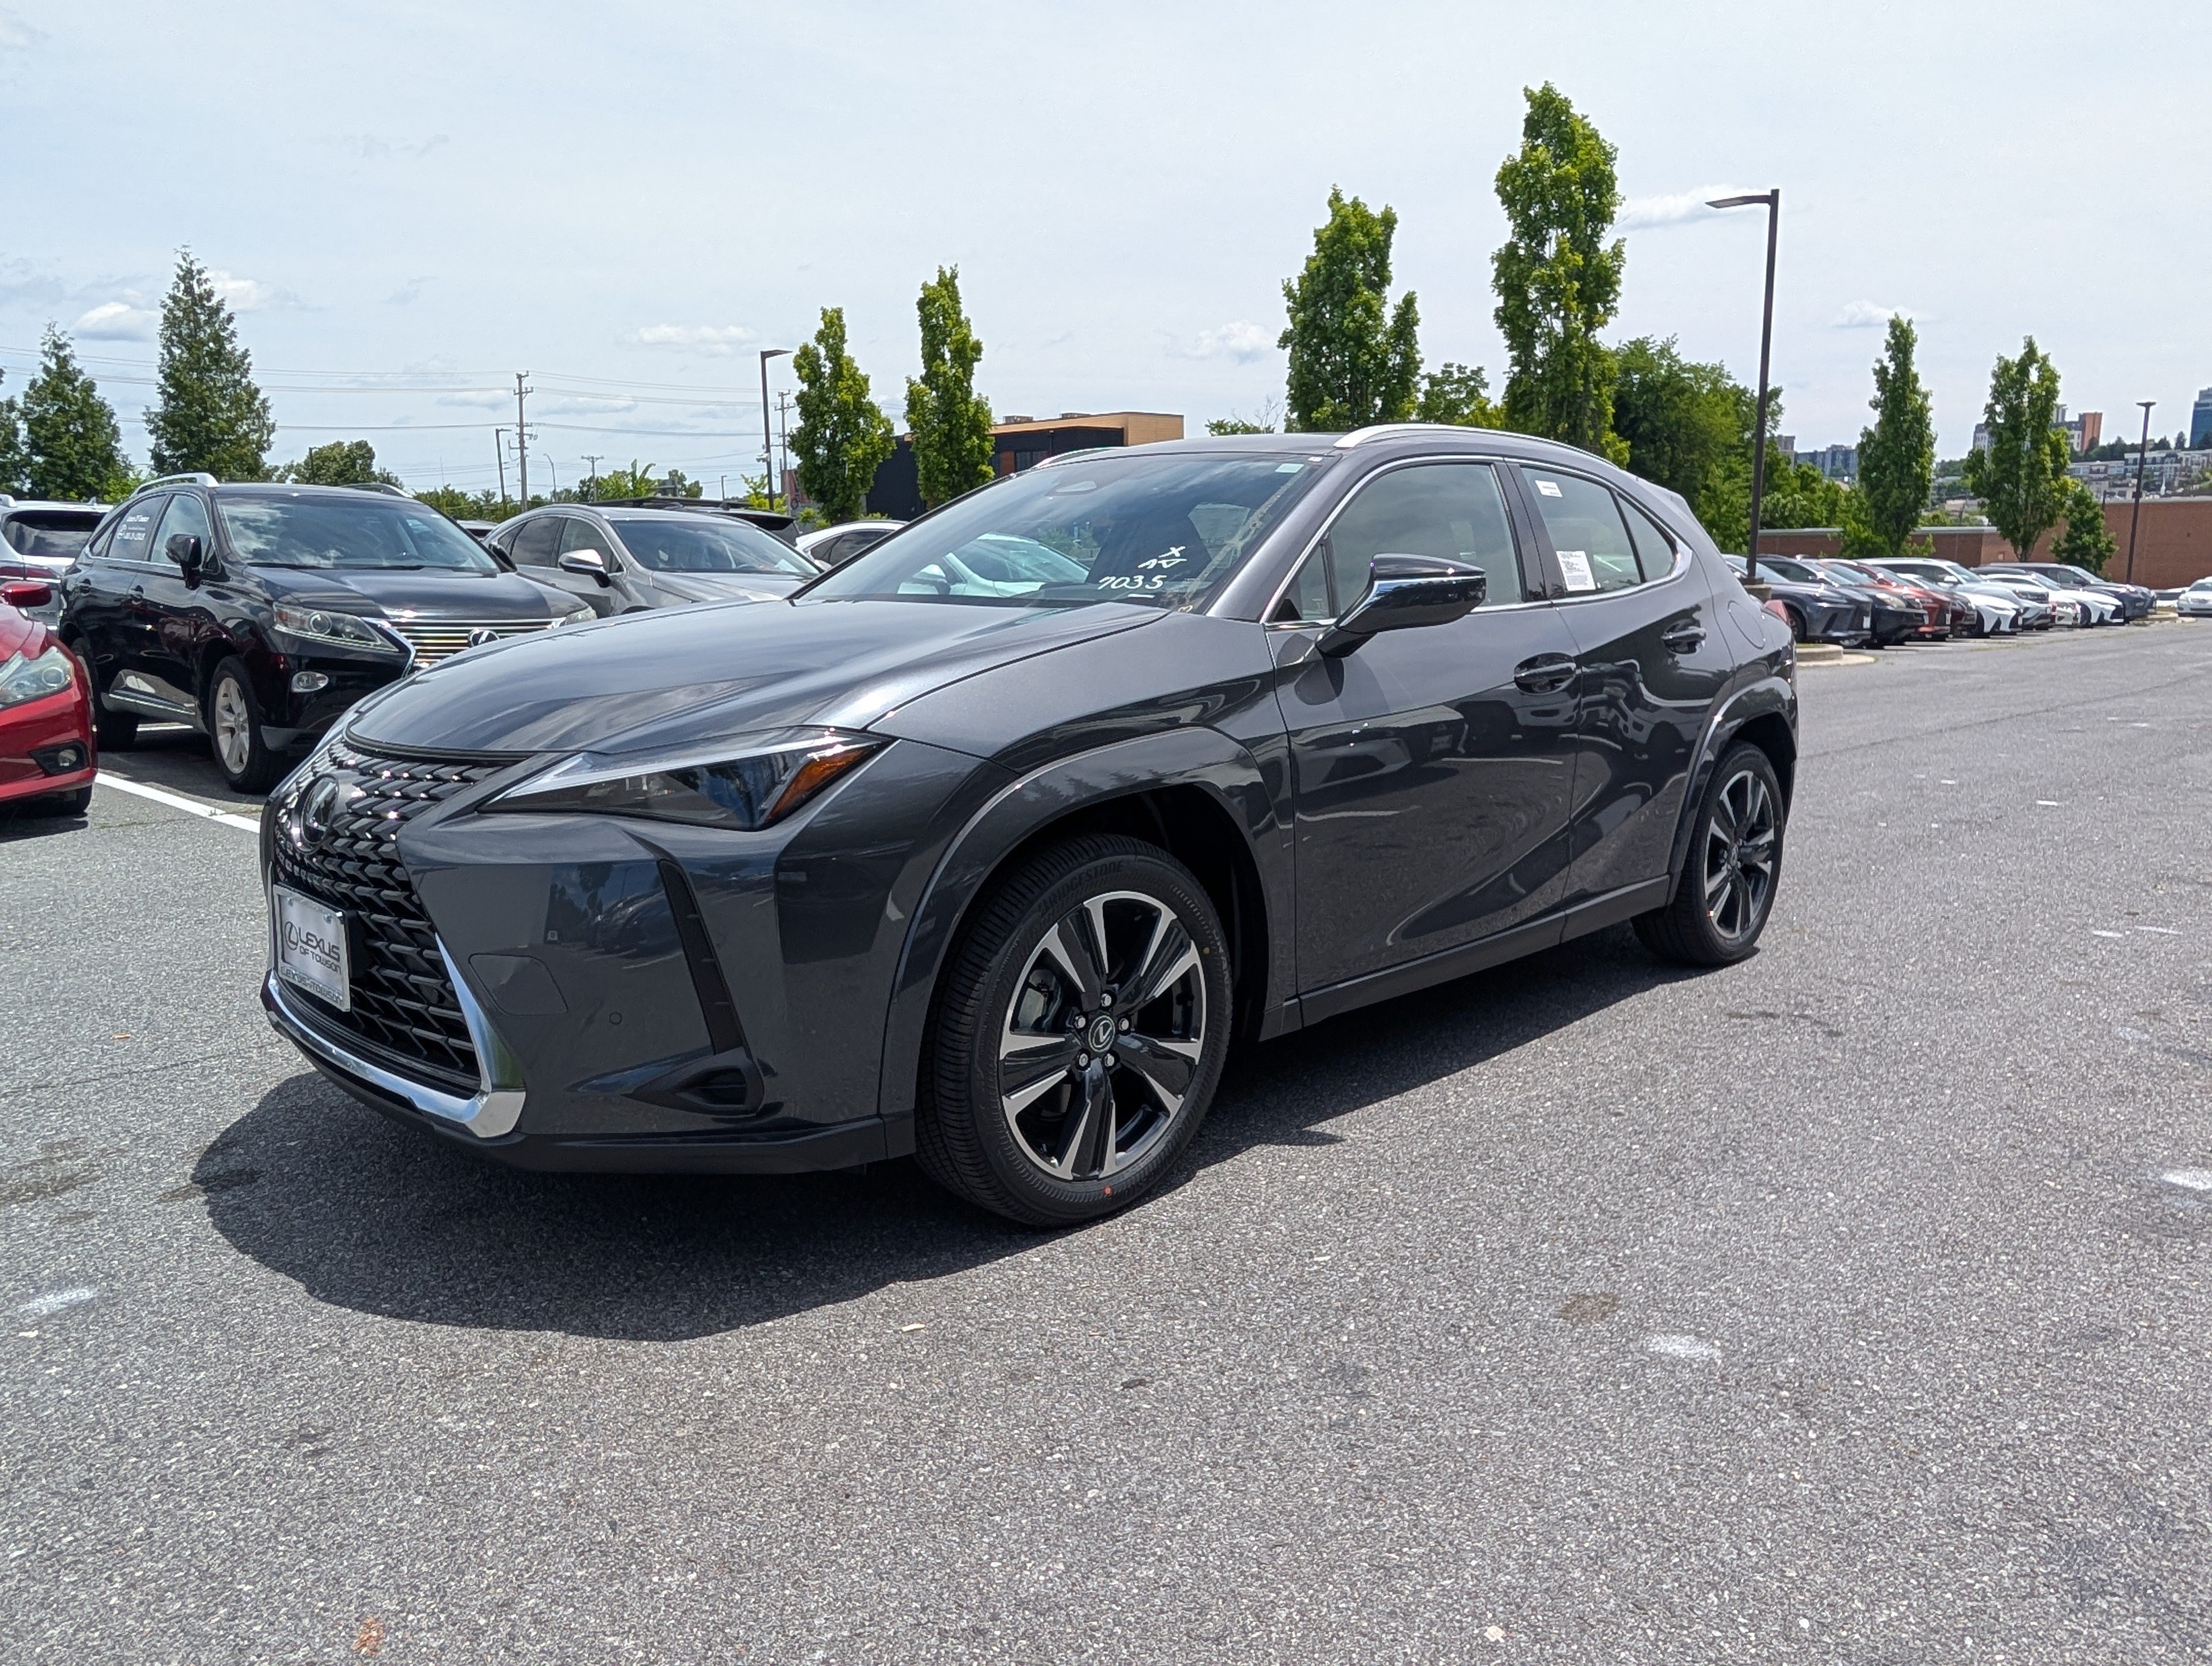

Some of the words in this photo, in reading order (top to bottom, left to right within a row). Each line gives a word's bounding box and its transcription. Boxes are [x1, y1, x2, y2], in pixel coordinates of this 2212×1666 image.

[1097, 575, 1167, 590] 7035
[1037, 860, 1123, 914] BRIDGESTONE
[299, 926, 340, 963] LEXUS
[299, 945, 310, 956] OF
[310, 951, 342, 975] TOWSON
